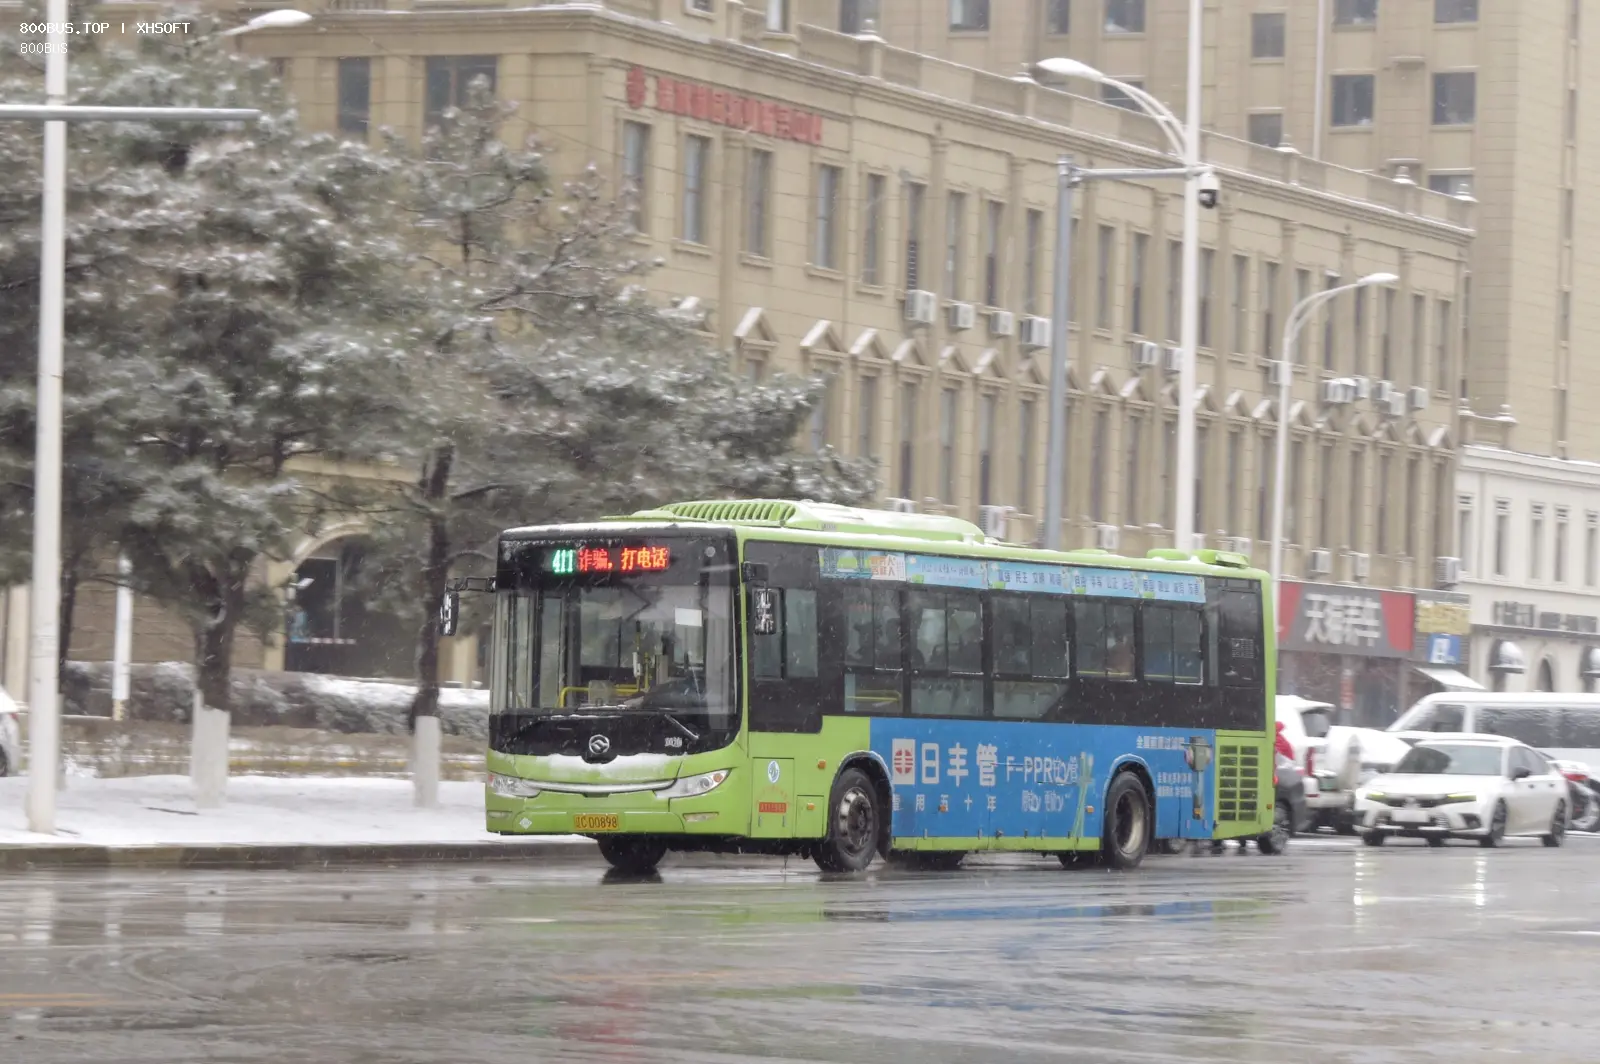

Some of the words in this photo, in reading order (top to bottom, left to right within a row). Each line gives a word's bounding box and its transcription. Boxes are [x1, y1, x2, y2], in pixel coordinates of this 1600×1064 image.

[552, 549, 573, 573] 411
[921, 742, 998, 787] 日丰管
